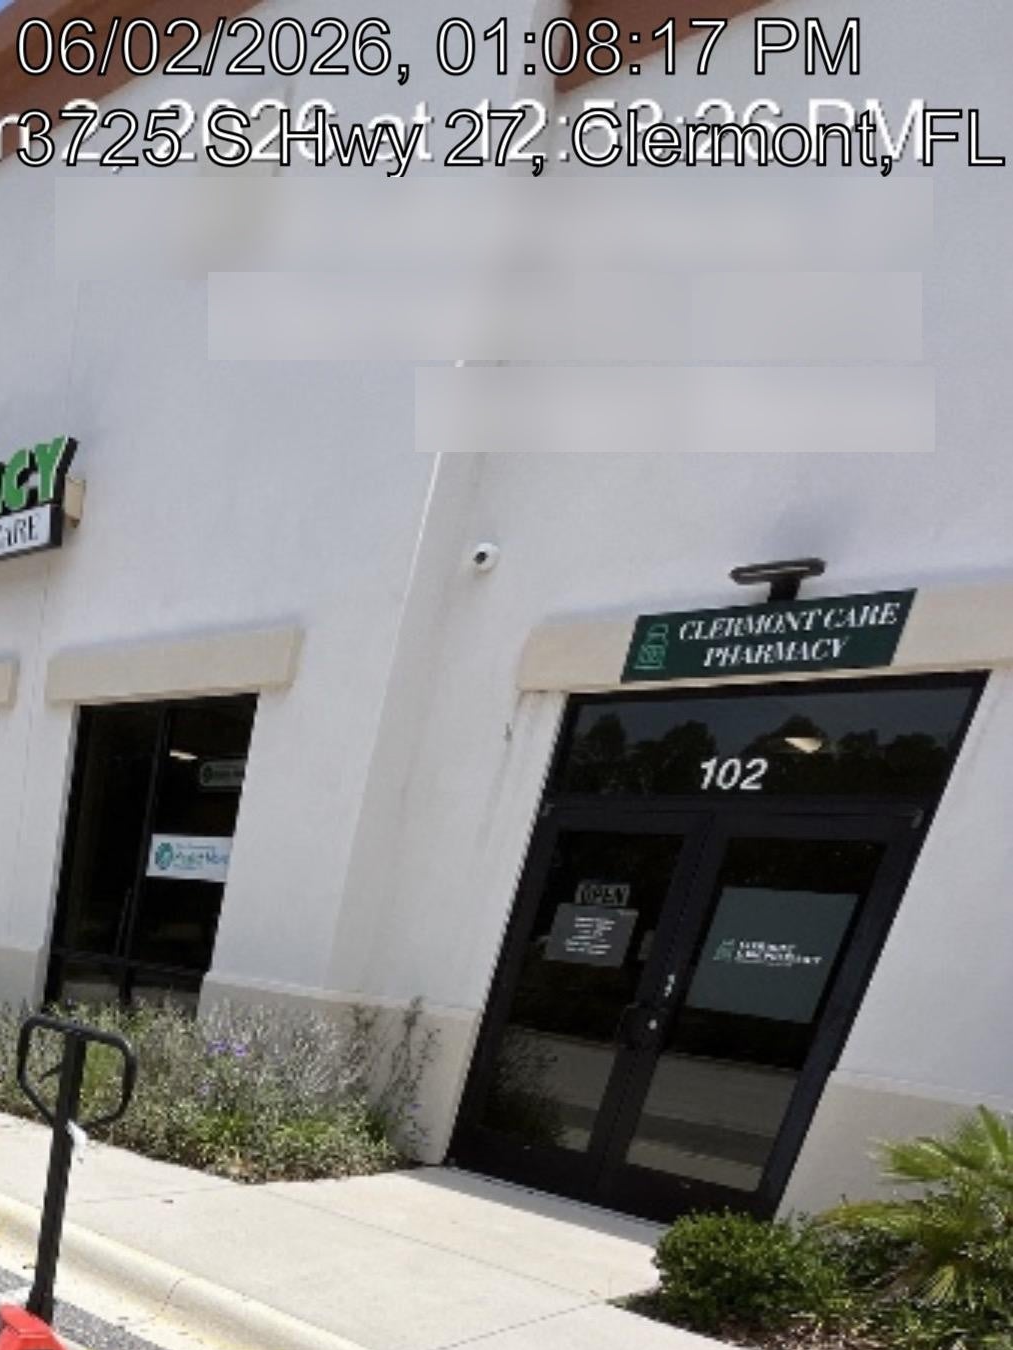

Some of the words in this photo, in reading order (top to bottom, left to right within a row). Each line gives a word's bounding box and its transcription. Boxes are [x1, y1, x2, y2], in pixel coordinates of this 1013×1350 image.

[679, 608, 822, 641] CLERMONT
[823, 602, 901, 628] CARE
[703, 636, 849, 668] PHARMACY
[700, 757, 769, 791] 102
